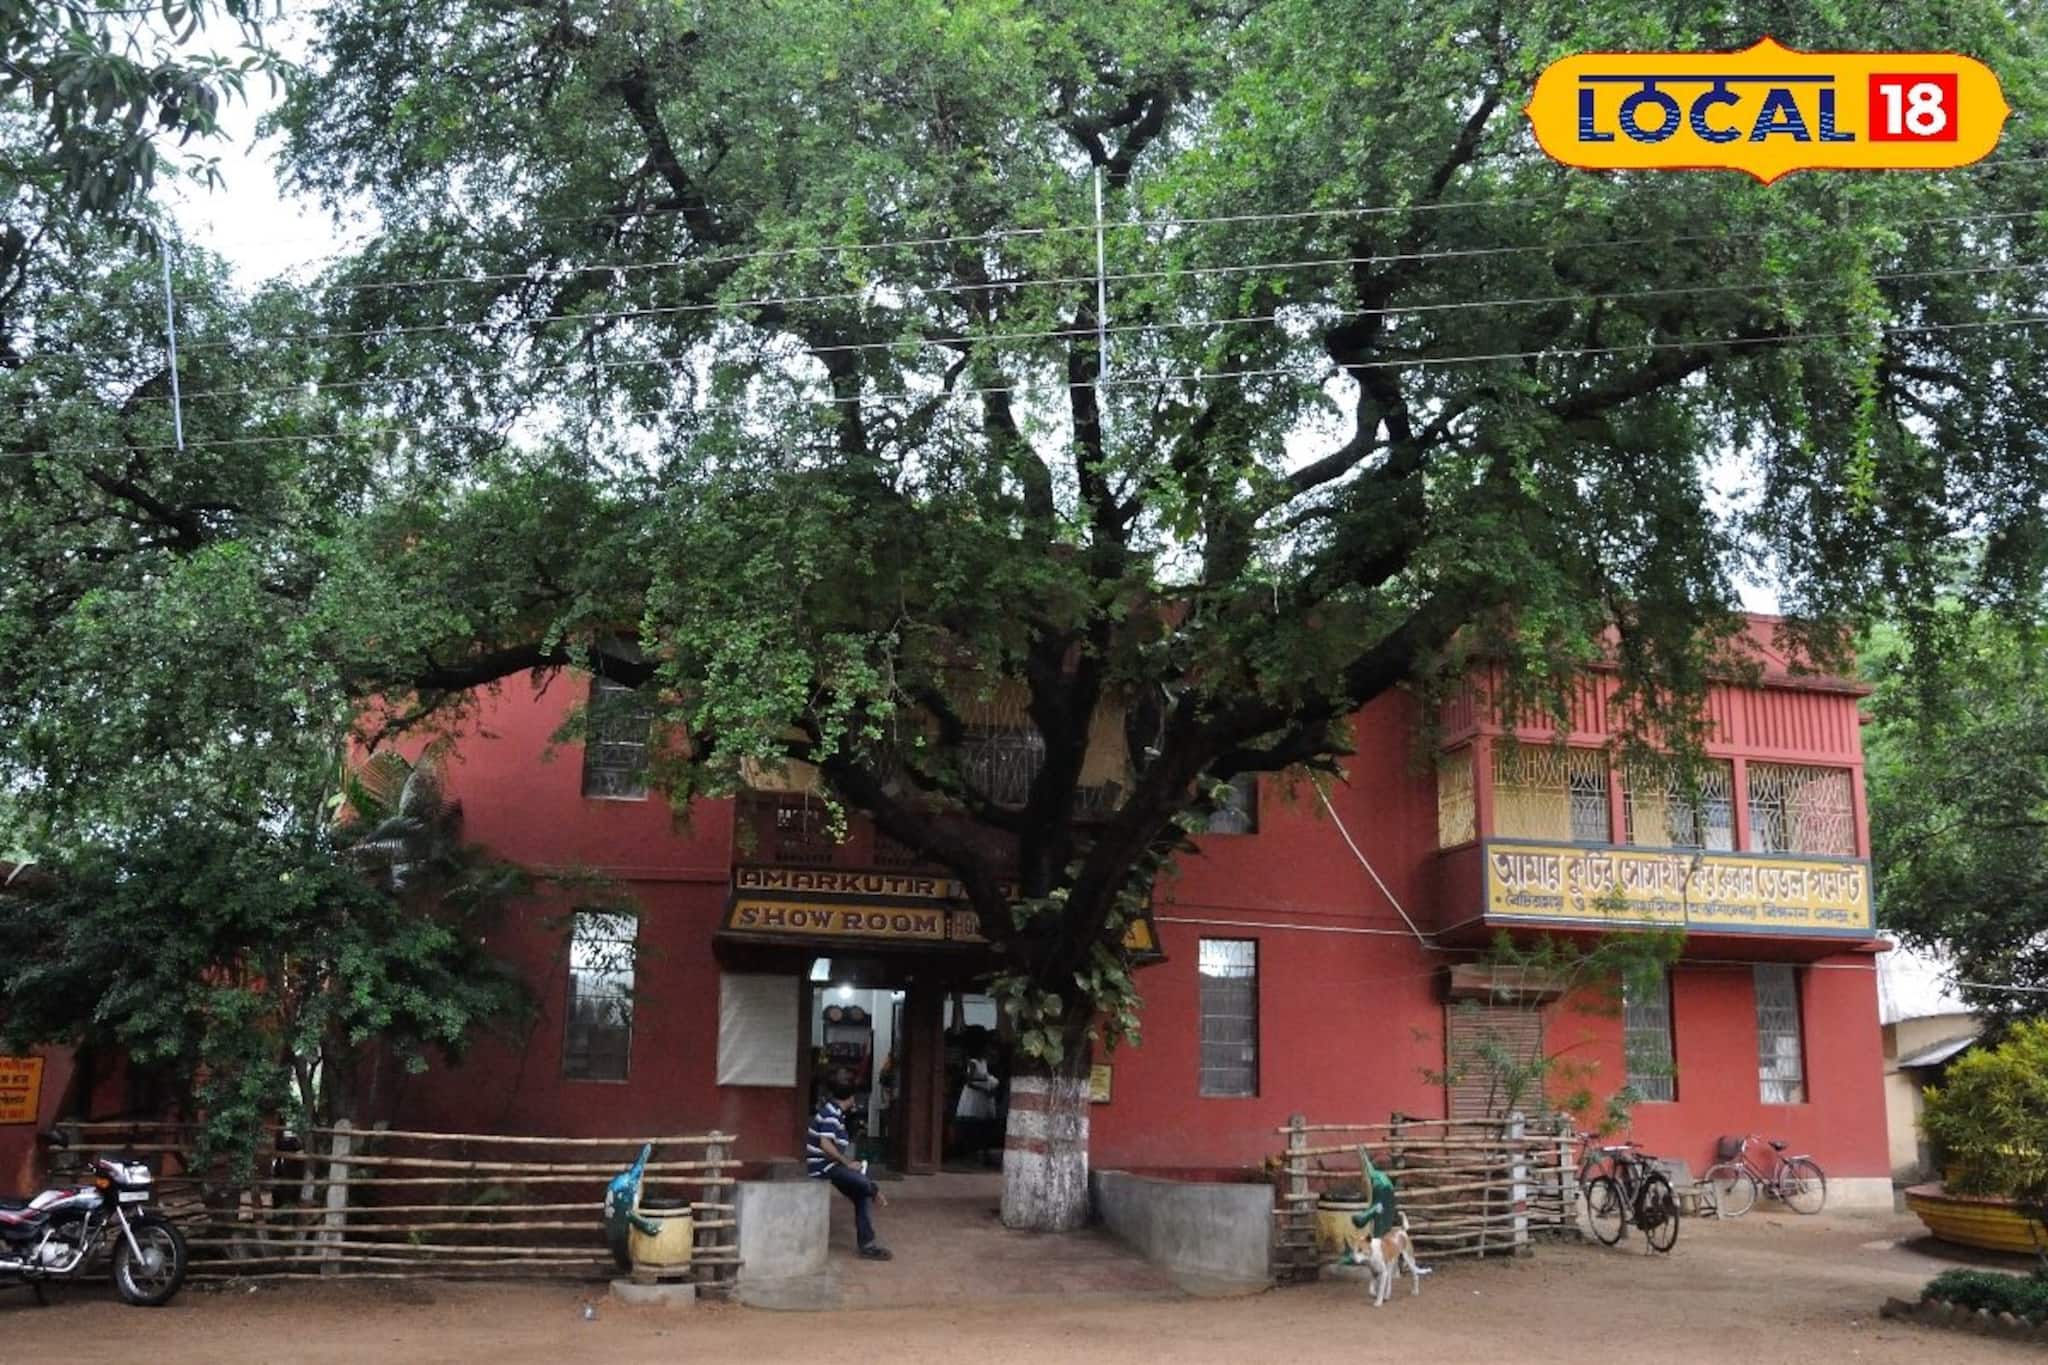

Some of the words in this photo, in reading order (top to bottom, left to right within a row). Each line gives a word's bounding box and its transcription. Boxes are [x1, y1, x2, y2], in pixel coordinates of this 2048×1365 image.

[740, 870, 936, 896] AMARKUTIR
[1490, 852, 1564, 892] আমার
[1568, 852, 1616, 896] কুটির
[740, 906, 835, 929] SHOW
[840, 911, 937, 933] ROOM
